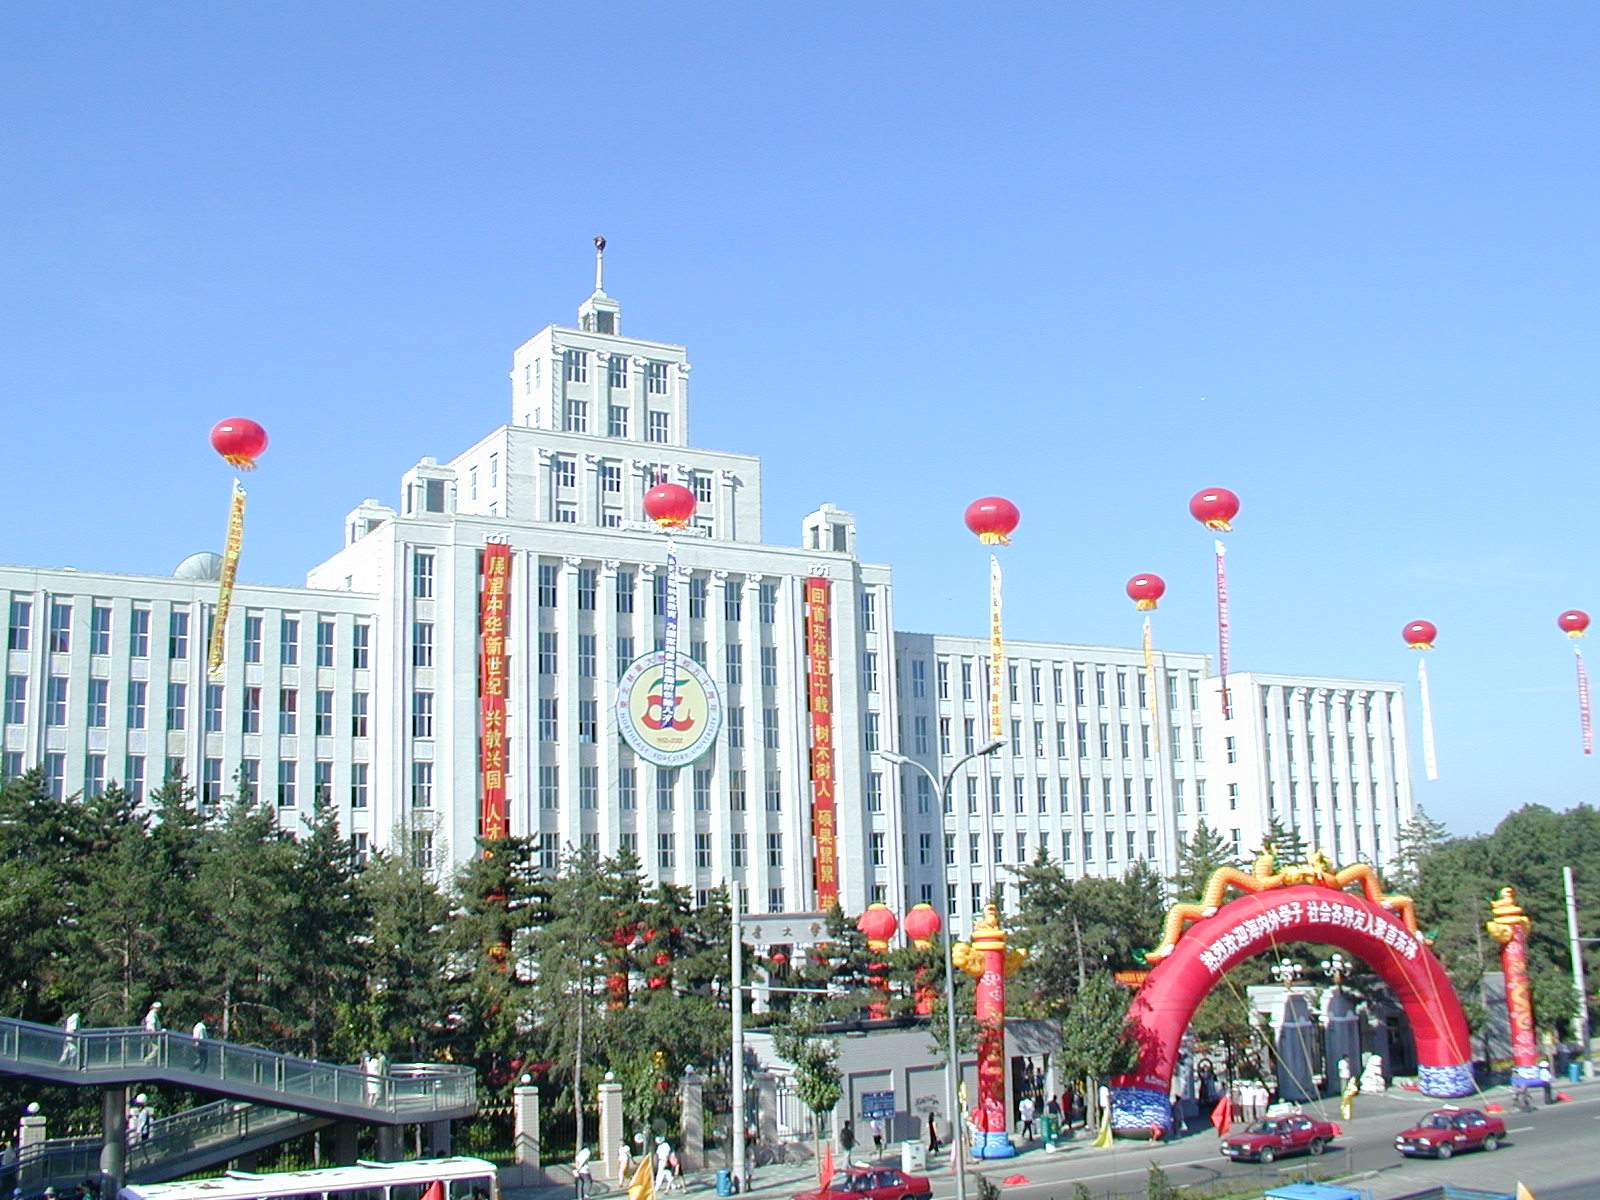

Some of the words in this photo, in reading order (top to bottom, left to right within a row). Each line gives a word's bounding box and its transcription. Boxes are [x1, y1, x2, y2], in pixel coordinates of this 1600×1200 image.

[485, 556, 505, 696] 展望中华新世纪
[811, 587, 830, 713] 回首东林五十载
[815, 724, 831, 798] 树木树人
